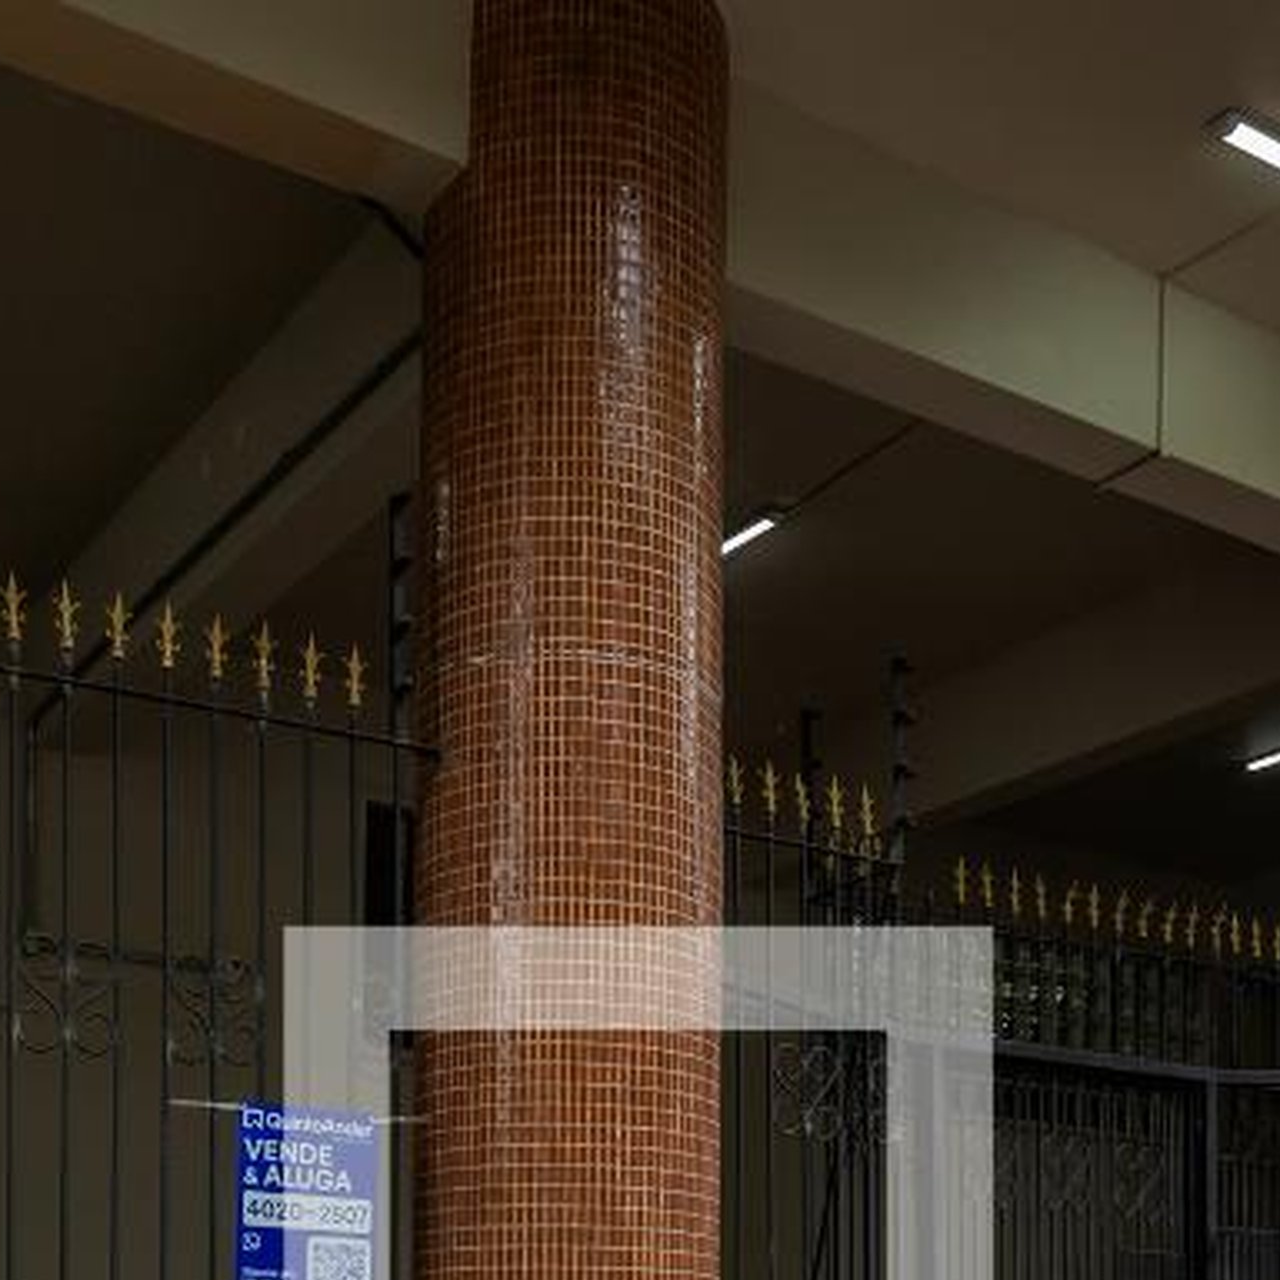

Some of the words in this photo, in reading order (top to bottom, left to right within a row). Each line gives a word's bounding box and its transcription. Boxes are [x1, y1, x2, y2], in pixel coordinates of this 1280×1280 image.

[243, 1139, 333, 1167] VENDE
[243, 1166, 258, 1186] &
[262, 1164, 352, 1193] ALUGA
